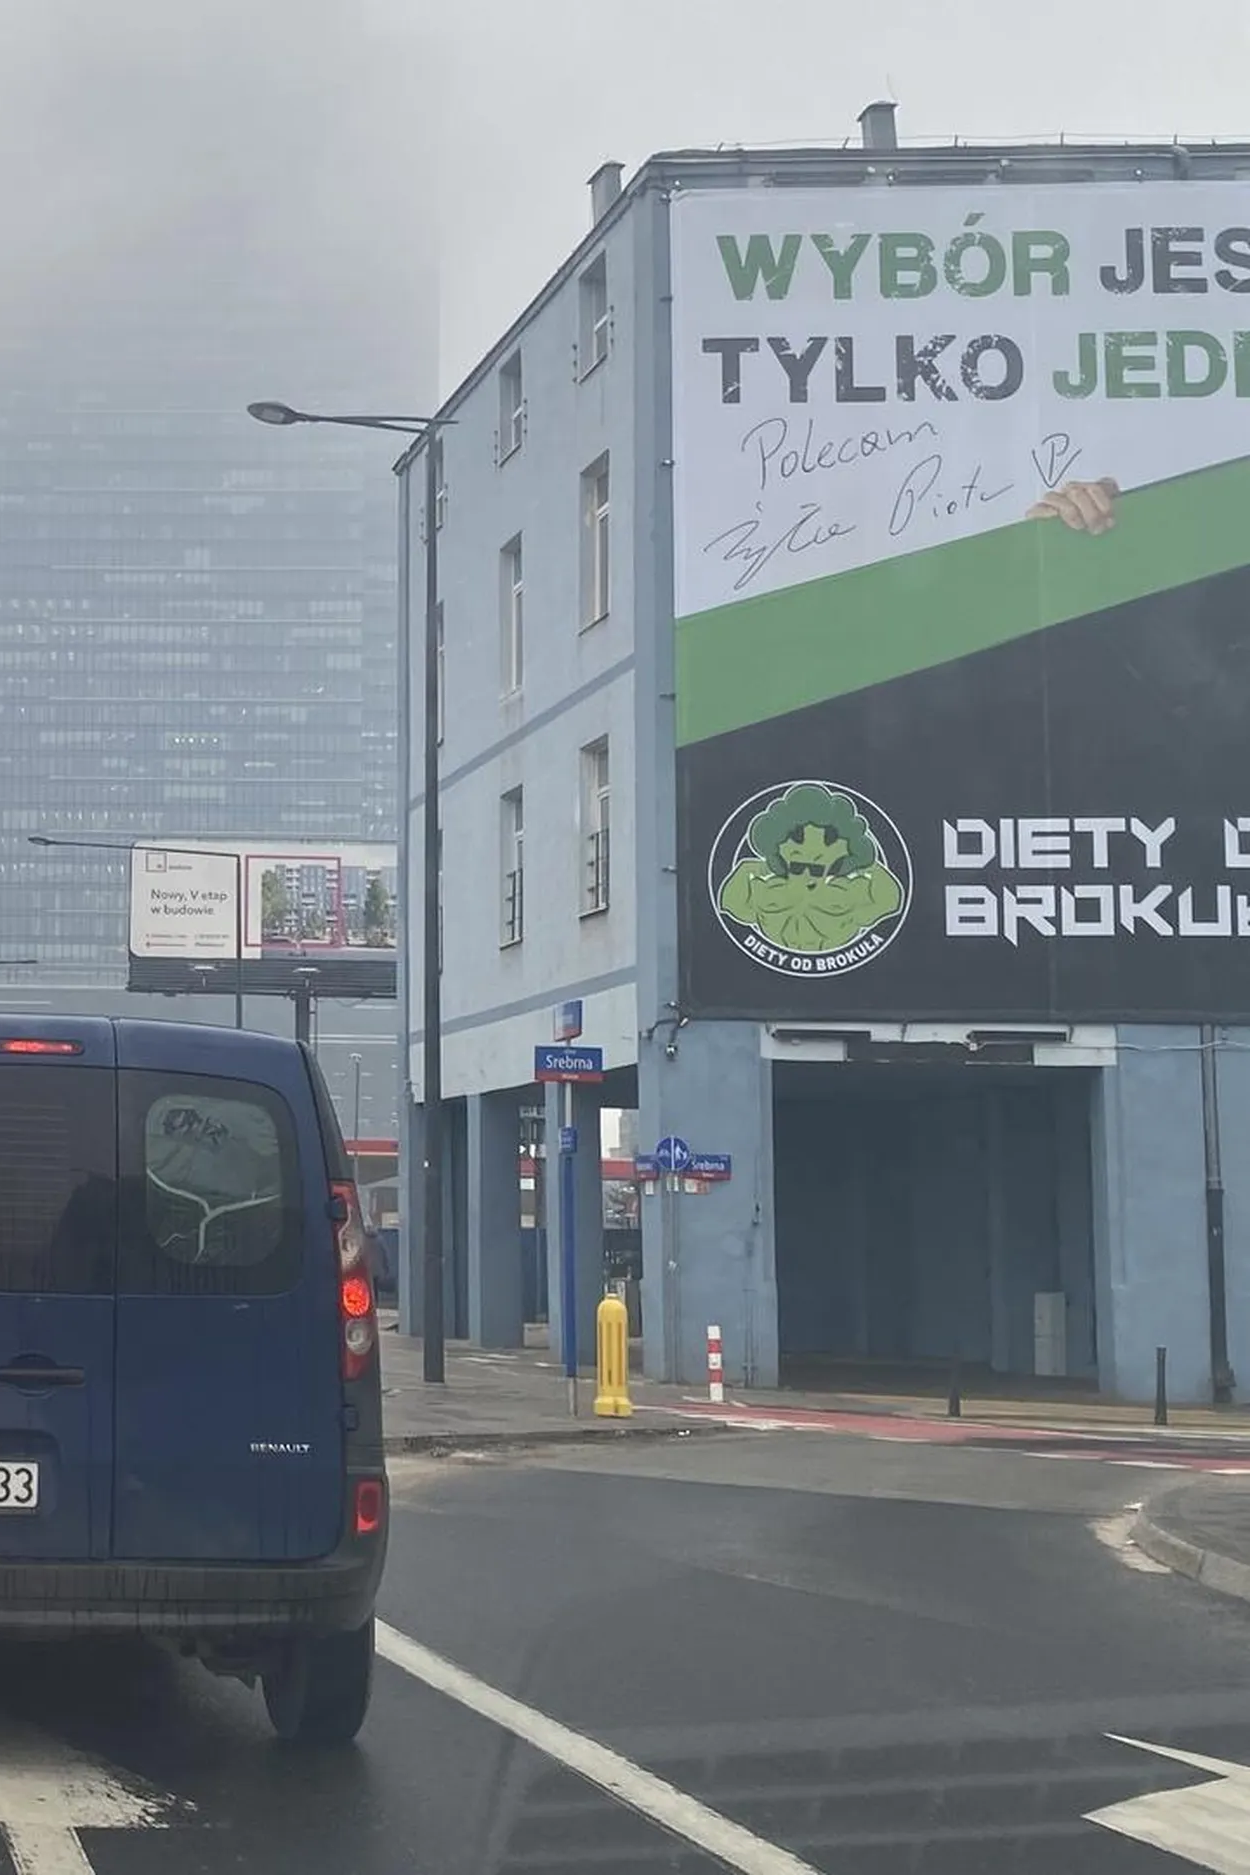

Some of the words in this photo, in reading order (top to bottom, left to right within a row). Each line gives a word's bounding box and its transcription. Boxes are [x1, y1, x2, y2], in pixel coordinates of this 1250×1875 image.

[716, 212, 1071, 301] WYBÓR
[1100, 227, 1250, 294] JES
[702, 334, 1024, 403] TYLKO
[1053, 330, 1250, 399] JED
[741, 417, 938, 490] Polecam
[943, 817, 1176, 868] DIETY
[151, 889, 188, 902] Nowy,
[190, 890, 199, 900] V
[201, 891, 229, 903] etap
[151, 906, 161, 914] w
[164, 904, 214, 915] budowie
[945, 884, 1250, 948] BROKU
[744, 934, 788, 966] DIETY
[790, 957, 812, 971] OD
[816, 933, 885, 971] BROKUŁA
[545, 1054, 593, 1070] Srebrna
[251, 1443, 310, 1454] RENAULT
